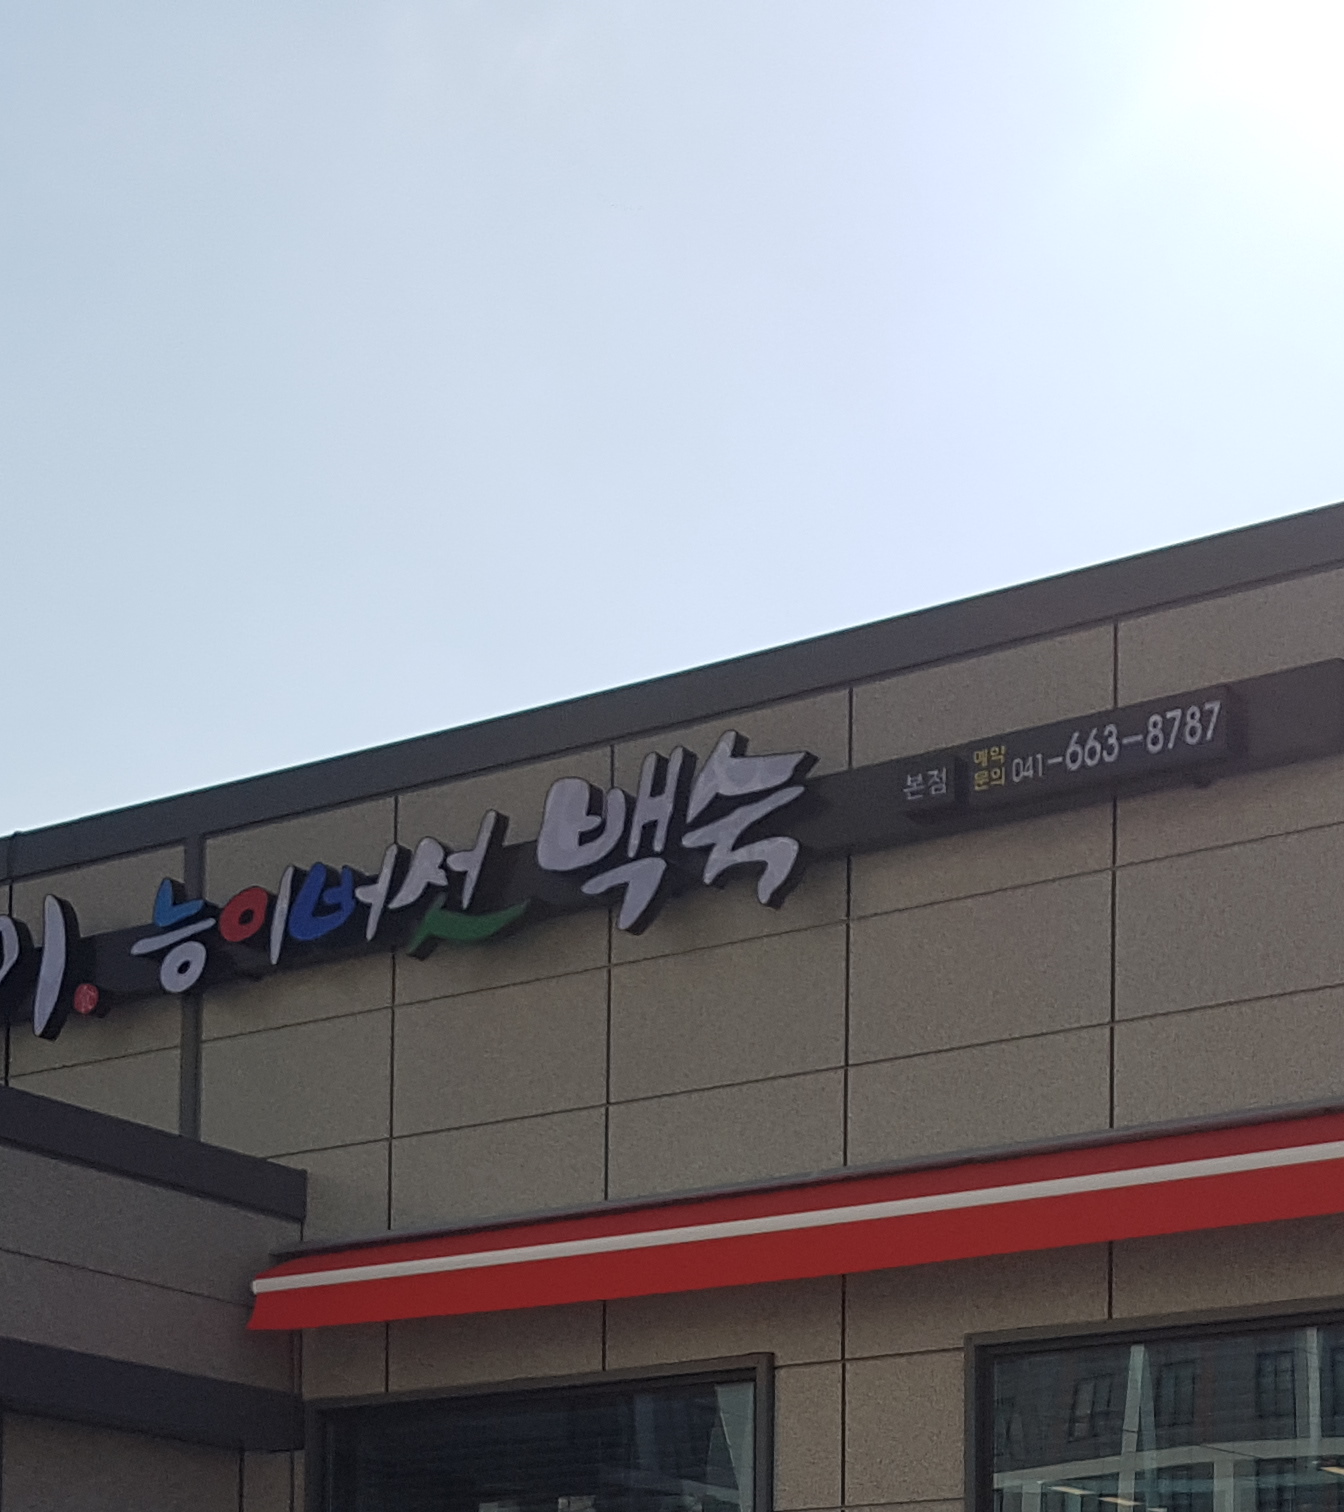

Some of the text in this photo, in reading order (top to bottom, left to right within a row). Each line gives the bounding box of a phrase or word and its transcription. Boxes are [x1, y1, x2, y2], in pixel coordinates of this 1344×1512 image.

[1011, 701, 1222, 782] 041-663-8787
[903, 766, 947, 800] 본점
[974, 766, 1006, 791] 문의
[130, 809, 528, 993] 능이버섯
[537, 730, 808, 932] 백숙
